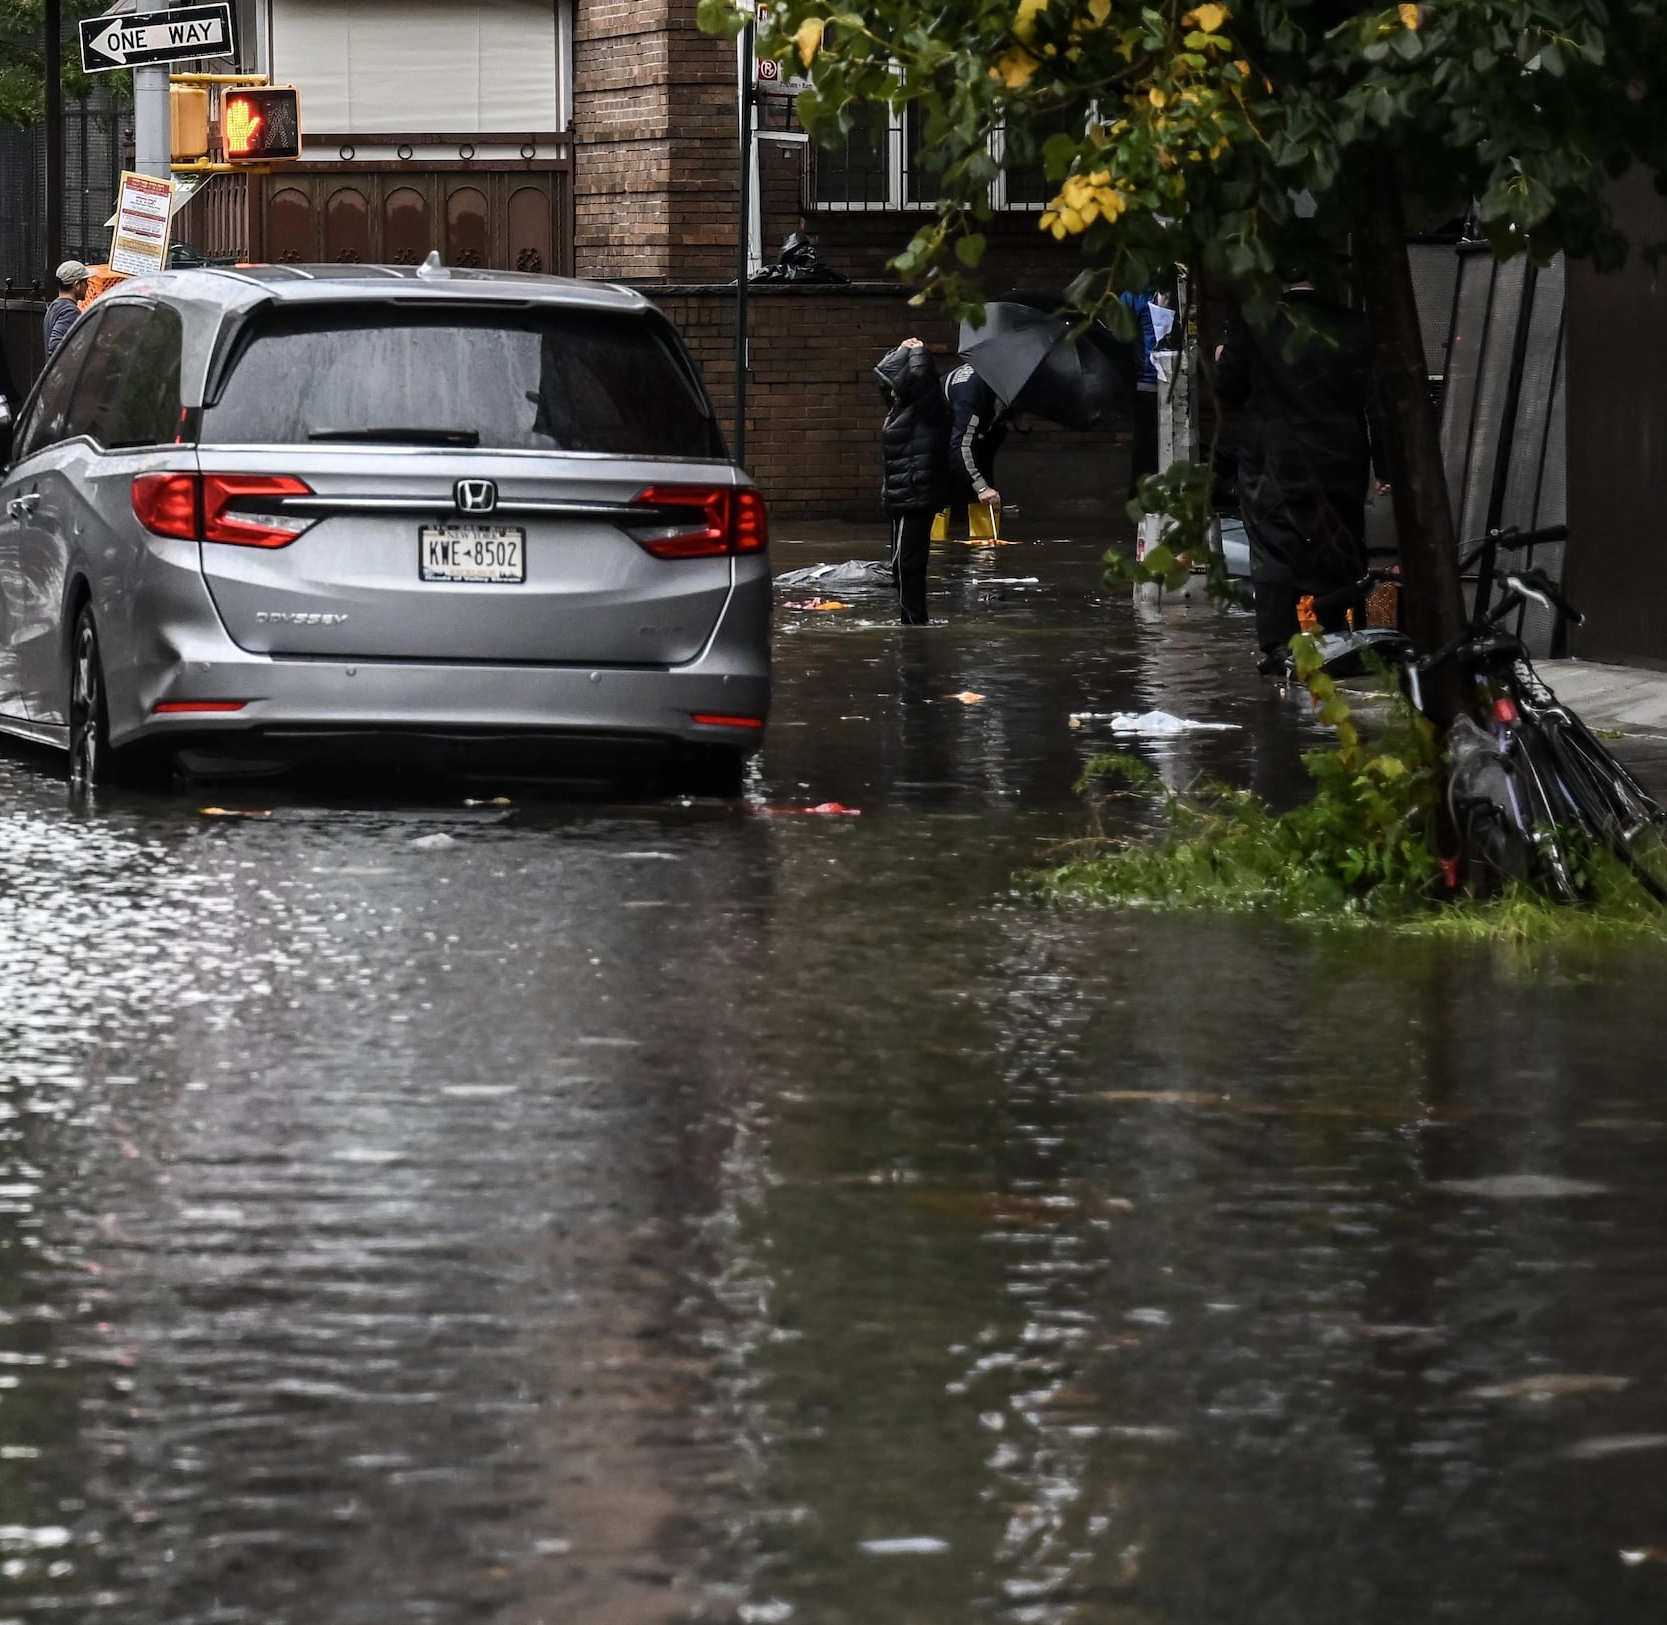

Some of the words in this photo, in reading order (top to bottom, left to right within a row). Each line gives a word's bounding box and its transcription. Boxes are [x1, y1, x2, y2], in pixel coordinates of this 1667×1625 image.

[107, 29, 148, 52] ONE
[168, 22, 212, 45] WAY
[447, 531, 469, 539] NEW
[429, 540, 461, 566] KWE
[474, 541, 517, 567] 8502
[255, 611, 349, 625] ODYSSEY
